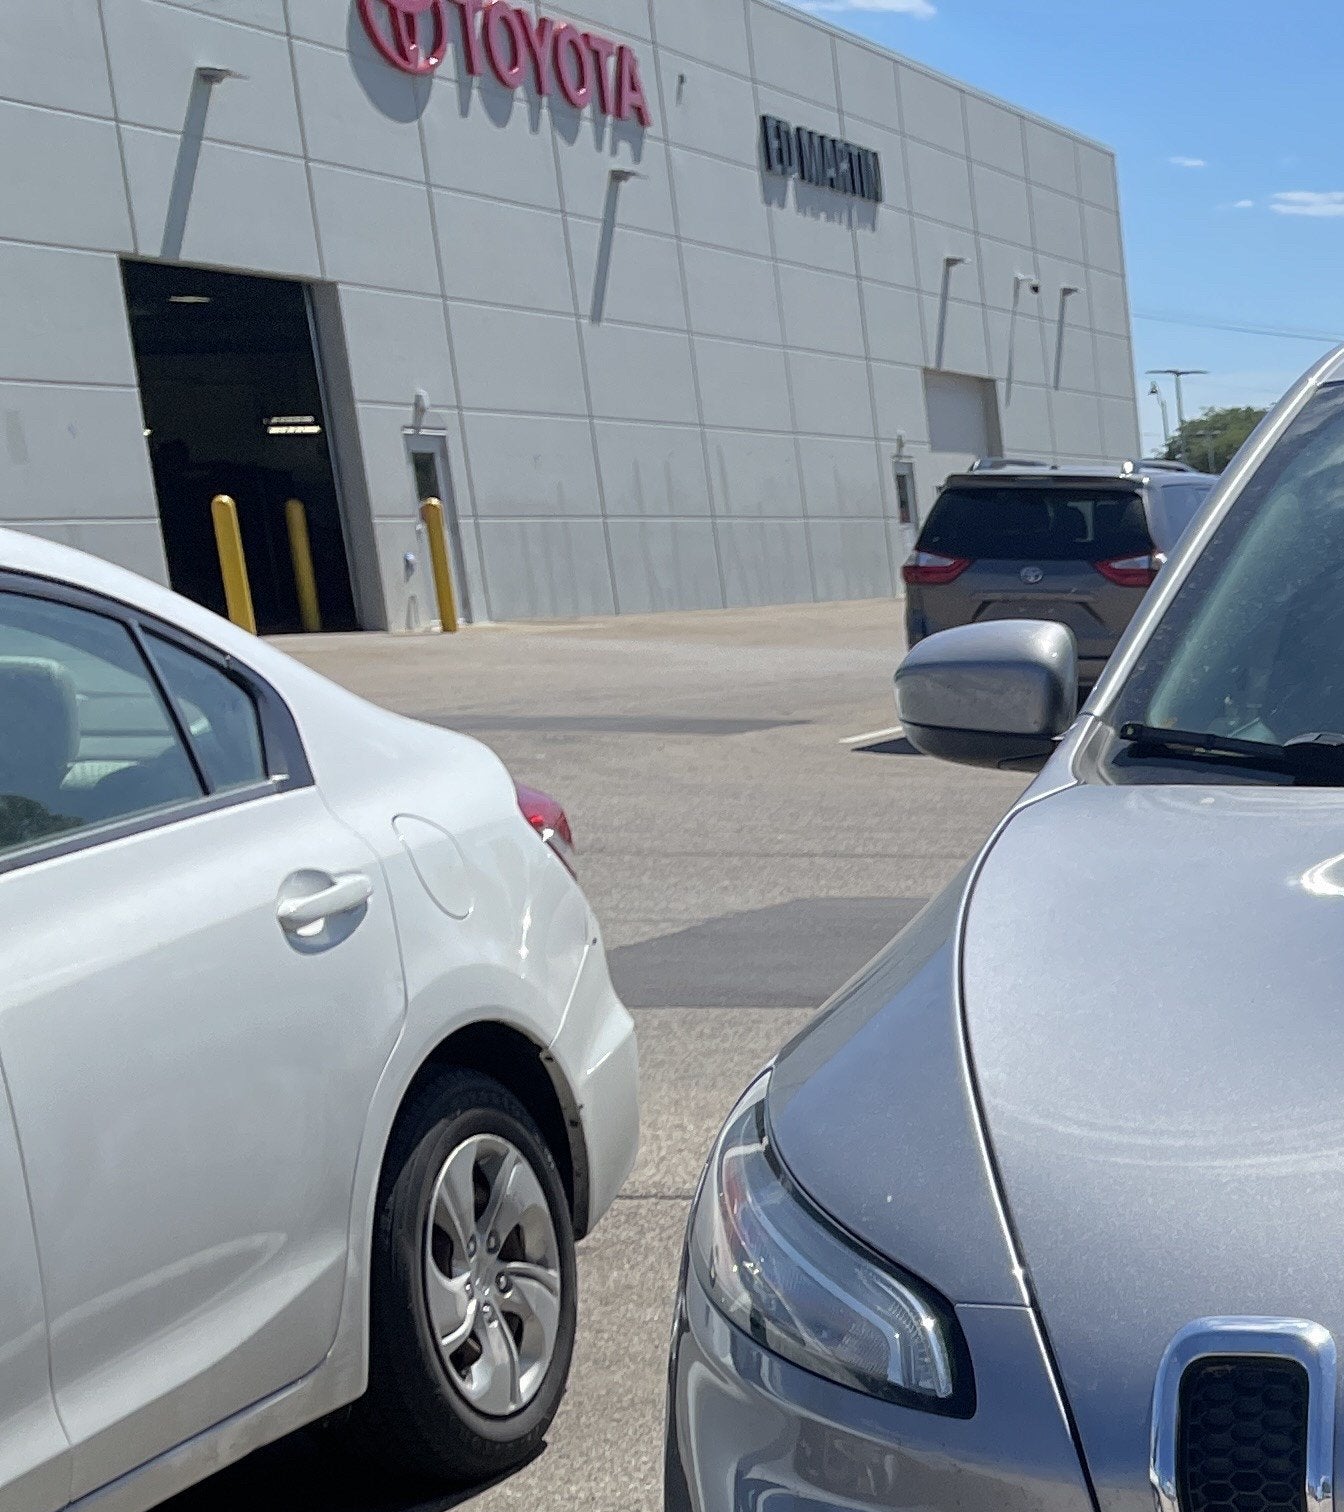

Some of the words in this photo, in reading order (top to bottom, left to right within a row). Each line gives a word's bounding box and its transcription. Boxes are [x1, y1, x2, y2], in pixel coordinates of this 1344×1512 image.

[450, 0, 652, 127] TOYOTA
[760, 114, 797, 177] ED
[795, 126, 884, 203] MARTIN
